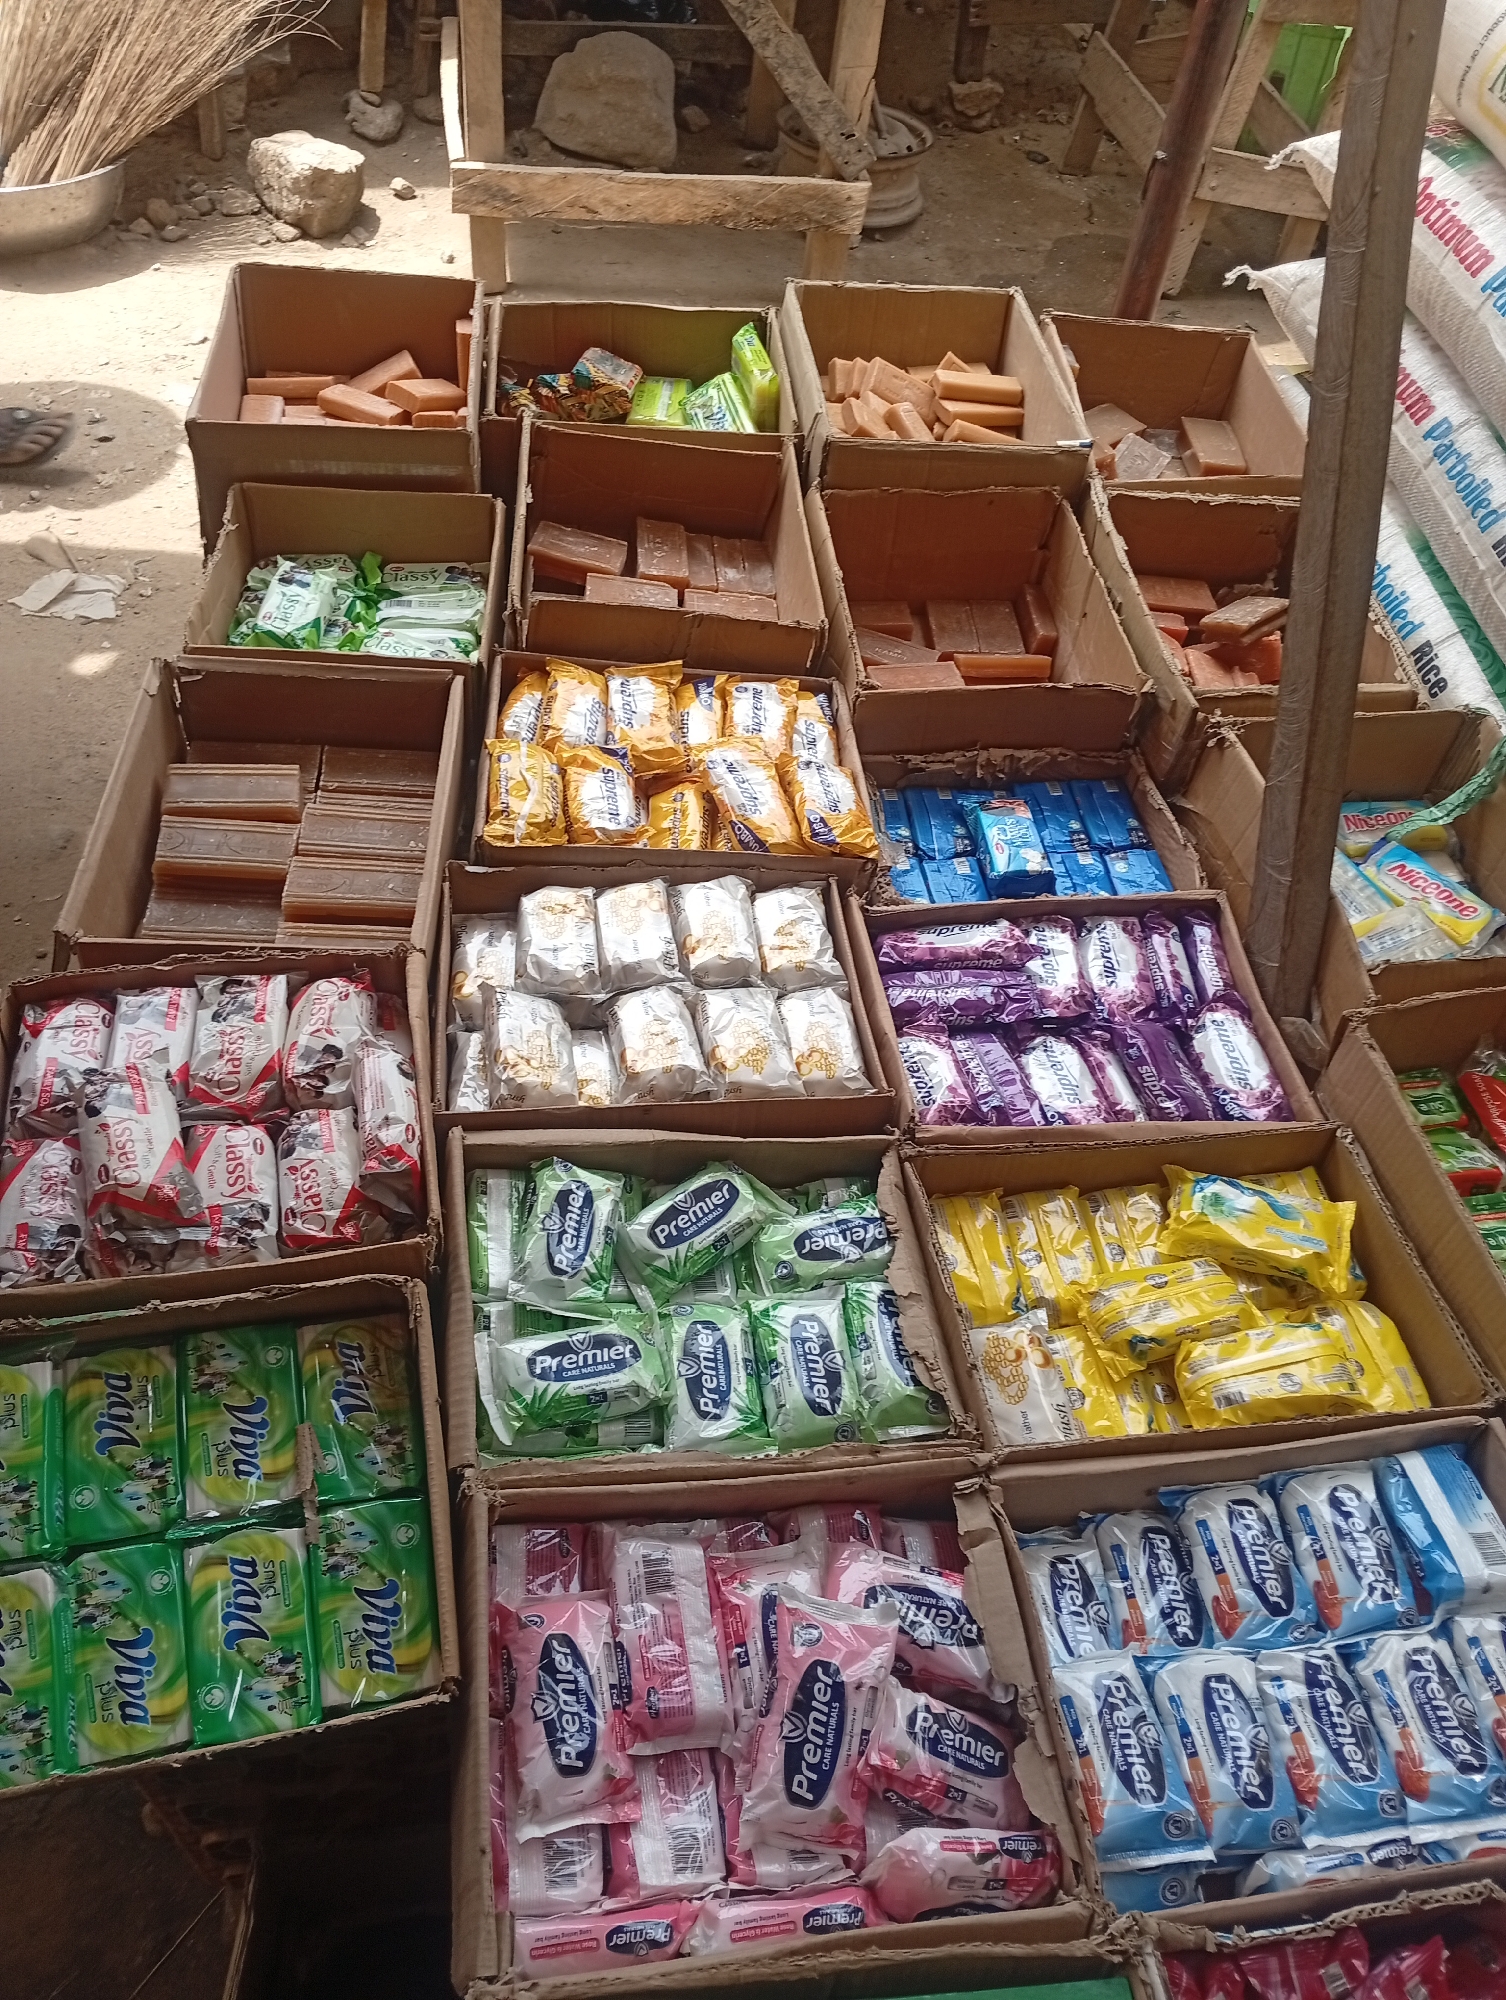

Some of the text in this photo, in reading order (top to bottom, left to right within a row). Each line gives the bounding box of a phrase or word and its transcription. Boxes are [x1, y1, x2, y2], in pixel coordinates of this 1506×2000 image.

[1422, 416, 1505, 534] Parboiled
[380, 567, 442, 584] Classy
[271, 590, 302, 632] Classy
[1371, 562, 1448, 699] boiled Rice
[364, 635, 425, 657] Classy
[602, 767, 621, 826] supreme
[722, 758, 762, 816] supreme
[816, 761, 841, 814] supreme
[1343, 811, 1415, 832] Niceon
[1387, 862, 1479, 918] Niceone
[1095, 923, 1118, 989] supreme
[62, 1002, 100, 1063] Classy
[303, 980, 339, 1041] Classy
[217, 1026, 245, 1095] Classy
[900, 1041, 936, 1107] supreme
[1046, 1039, 1081, 1104] supreme
[1211, 1019, 1253, 1090] supreme
[104, 1115, 141, 1189] Classy
[206, 1165, 216, 1190] Gentle
[221, 1127, 252, 1199] Classy
[30, 1150, 73, 1220] Classy
[293, 1158, 327, 1233] Classy
[654, 1183, 732, 1245] Premier
[553, 1184, 586, 1272] Premier
[576, 1208, 589, 1253] CARE NATURALS
[683, 1207, 724, 1237] CARE NATURALS
[802, 1221, 888, 1253] Premier
[535, 1344, 635, 1374] Premier
[562, 1362, 616, 1377] CARE NATURALS
[699, 1323, 721, 1415] Premier
[716, 1344, 727, 1390] CARE NATURALS
[795, 1340, 810, 1387] CARE NATURALS
[799, 1319, 833, 1413] Premier
[886, 1330, 900, 1360] NATURALS
[1, 1393, 20, 1430] plus
[133, 1375, 149, 1410] plus
[331, 1340, 378, 1424] Viva
[94, 1371, 141, 1456] Viva
[221, 1395, 270, 1483] Viva
[1020, 1410, 1031, 1434] lather
[212, 1440, 230, 1477] plus
[1210, 1554, 1223, 1571] 2in1
[1236, 1529, 1263, 1583] CARE NATURALS
[1238, 1503, 1287, 1610] Premier
[1333, 1490, 1399, 1596] Premier
[221, 1555, 271, 1651] Viva
[261, 1559, 280, 1600] plus
[1058, 1557, 1097, 1656] Premie
[1148, 1533, 1194, 1641] Premier
[1149, 1559, 1171, 1613] CARE NATURALS
[6, 1608, 27, 1650] plus
[353, 1578, 402, 1675] Viva
[767, 1618, 777, 1639] CARE
[1055, 1588, 1075, 1646] CARE NATURALS
[105, 1627, 157, 1726] Viva
[343, 1627, 362, 1670] plus
[95, 1681, 117, 1723] plus
[551, 1639, 584, 1768] Premier
[577, 1667, 590, 1734] CARE NATURALS
[1313, 1687, 1339, 1749] CARE NATURALS
[1317, 1660, 1370, 1779] Premier
[1411, 1654, 1480, 1767] Premier
[1415, 1683, 1447, 1744] CARE NATURALS
[793, 1666, 834, 1800] Premier
[822, 1702, 839, 1770] CARE NATURALS
[915, 1712, 1004, 1766] Premier
[938, 1744, 986, 1770] CARE NATURALS
[1102, 1680, 1158, 1798] Premier
[1102, 1708, 1127, 1772] CARE NATURALS
[1182, 1736, 1195, 1755] 2in1
[1209, 1680, 1266, 1801] Premier
[1210, 1712, 1237, 1773] CARE NATURALS
[609, 1926, 672, 1947] Premier
[731, 1930, 755, 1940] Glycerin
[761, 1926, 780, 1934] Water
[806, 1910, 864, 1928] Premier
